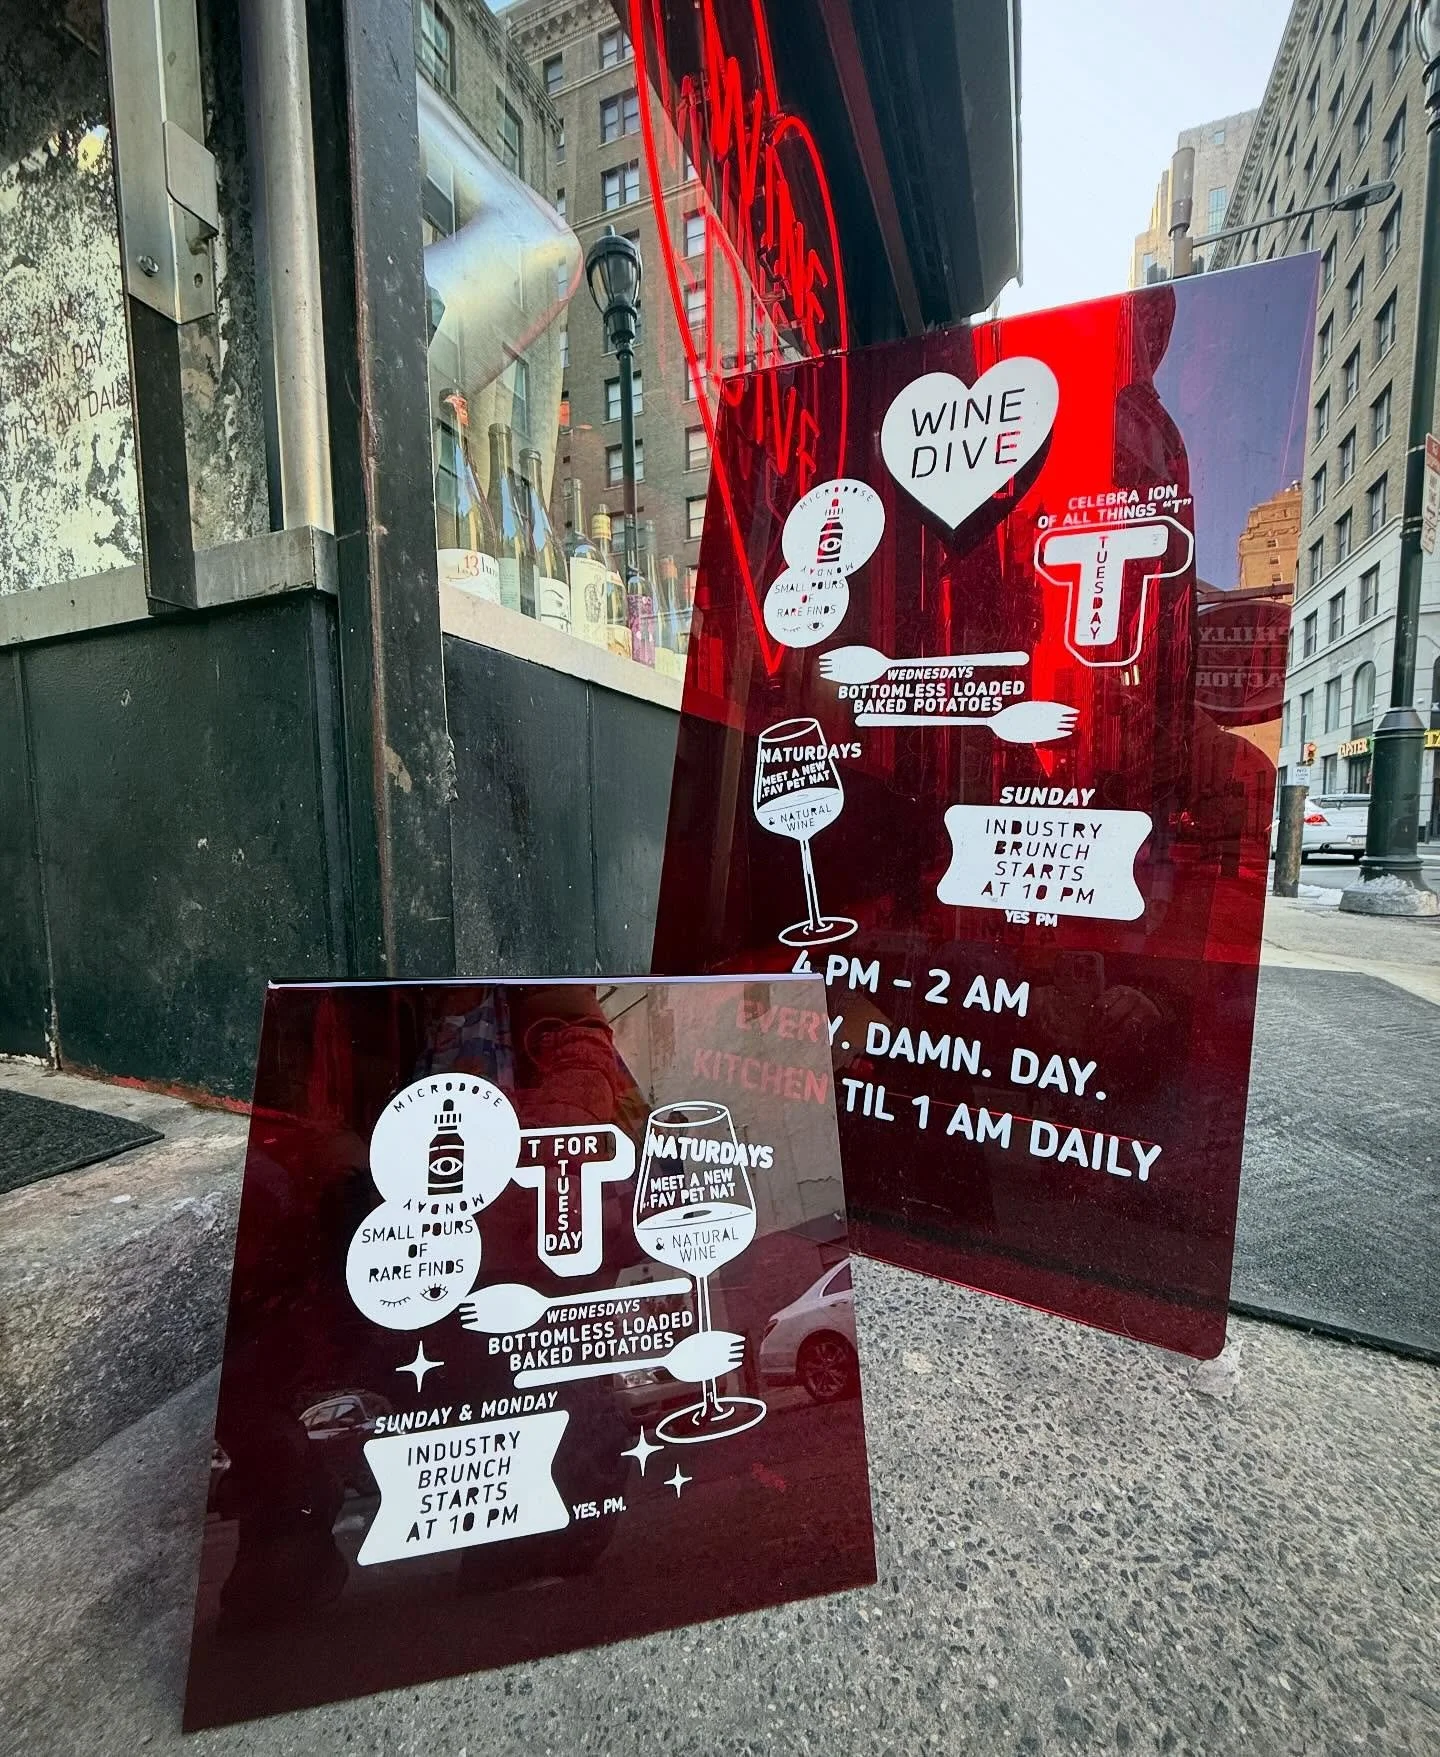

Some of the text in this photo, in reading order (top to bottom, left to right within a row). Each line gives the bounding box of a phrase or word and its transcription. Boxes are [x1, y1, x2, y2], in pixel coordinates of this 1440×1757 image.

[911, 387, 1026, 437] WINE
[911, 430, 1021, 479] DIVE
[799, 486, 874, 511] MICRODOSE
[1037, 514, 1056, 530] OF
[1062, 511, 1090, 527] ALL
[1099, 502, 1157, 522] THINGS
[774, 579, 845, 594] SMALL POURS
[801, 593, 814, 604] OF
[1090, 534, 1110, 641] TUESDAY
[777, 604, 837, 618] RARE FINDS
[887, 666, 974, 681] WEDNESDAYS
[838, 680, 1026, 700] BOTTOMLESS LOADED
[853, 696, 1003, 714] BAKED POTATOES
[760, 742, 863, 764] NATURDAYS
[761, 760, 827, 787] MEET A NEW
[787, 777, 808, 792] PET
[809, 771, 831, 787] NAT
[1000, 786, 1096, 807] SUNDAY
[768, 803, 833, 826] & NATURAL
[786, 817, 817, 832] WINE
[985, 818, 1103, 839] INDUSTRY
[994, 840, 1091, 861] BRUNCH
[994, 861, 1085, 882] STARTS
[981, 880, 1095, 905] AT 10 PM
[1004, 909, 1058, 928] YES PM
[791, 949, 813, 974] 4
[825, 954, 881, 993] PM
[924, 968, 950, 1005] 2
[963, 975, 1030, 1018] AM
[866, 1021, 993, 1079] DAMN.
[1010, 1047, 1108, 1101] DAY.
[393, 1082, 503, 1113] MICRODOSE
[692, 1049, 1163, 1182] KITCHEN TIL 1 AM DAILY
[527, 1135, 598, 1158] T FOR
[648, 1133, 774, 1169] NATURDAYS
[650, 1168, 733, 1192] MEET A NEW
[681, 1187, 706, 1205] PET
[710, 1183, 736, 1201] NAT
[361, 1219, 474, 1244] SMALL POURS
[655, 1227, 739, 1251] & NATURAL
[407, 1242, 428, 1258] OF
[679, 1245, 717, 1264] WINE
[368, 1258, 464, 1283] RARE FINDS
[546, 1299, 641, 1324] WEDNESDAYS
[488, 1310, 693, 1356] BOTTOMLESS LOADED
[510, 1331, 675, 1372] BAKED POTATOES
[374, 1391, 559, 1435] SUNDAY & MONDAY
[406, 1430, 521, 1467] INDUSTRY
[418, 1456, 511, 1490] BRUNCH
[419, 1481, 508, 1515] STARTS
[572, 1496, 627, 1520] YES, PM.
[405, 1503, 519, 1543] AT 10 PM
